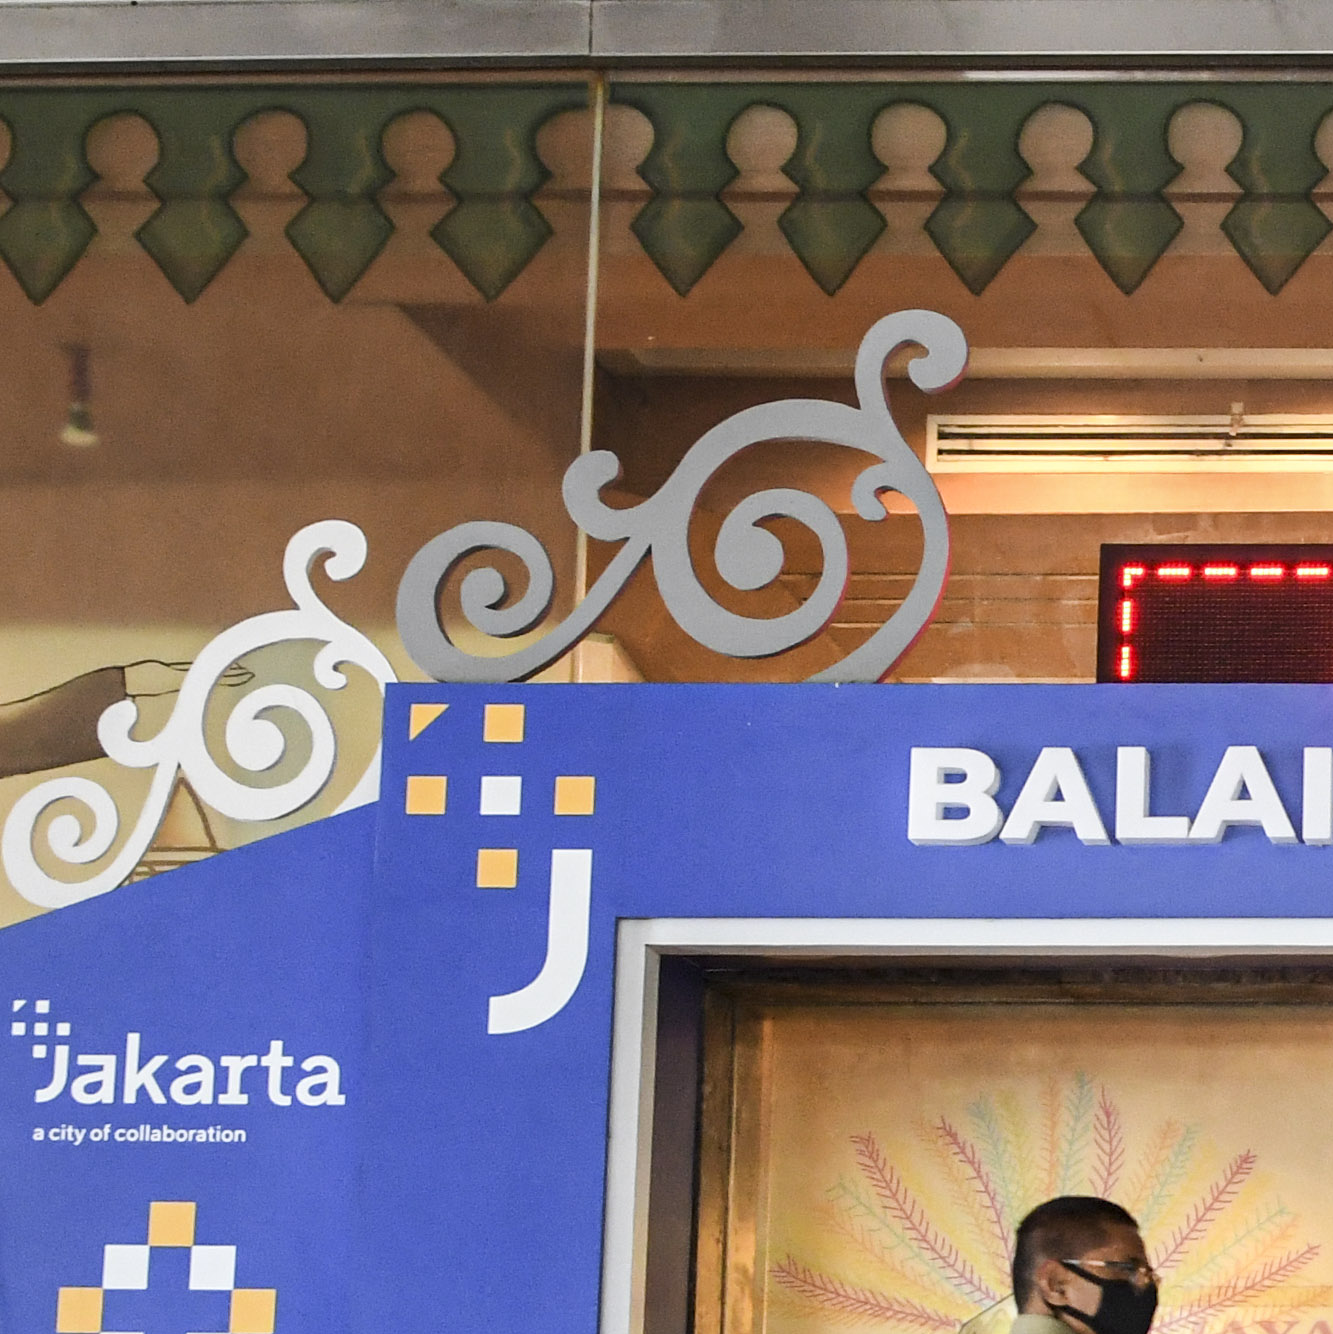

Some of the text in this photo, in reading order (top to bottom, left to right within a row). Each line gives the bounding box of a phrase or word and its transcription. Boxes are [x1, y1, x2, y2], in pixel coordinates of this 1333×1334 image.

[32, 1124, 247, 1146] a city of collaboration
